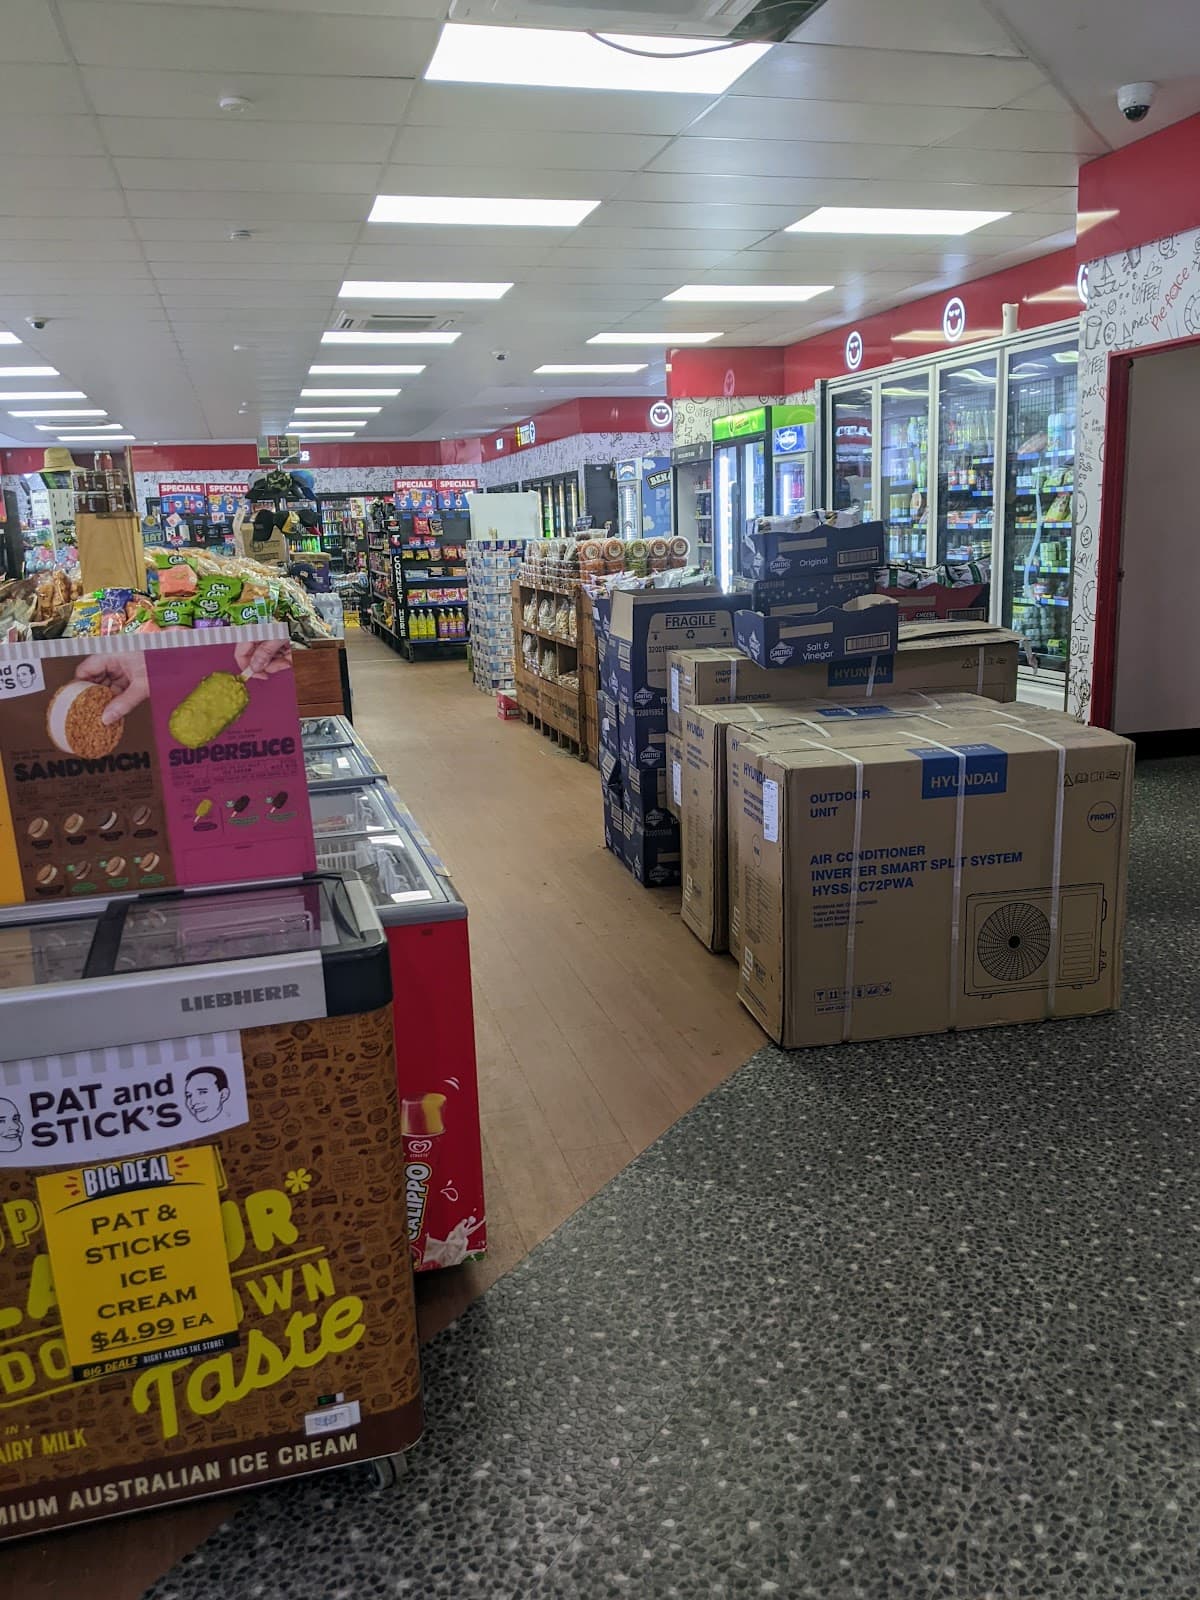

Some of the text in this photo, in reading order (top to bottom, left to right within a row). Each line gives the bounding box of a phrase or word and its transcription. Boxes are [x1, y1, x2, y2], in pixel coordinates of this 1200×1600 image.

[161, 485, 201, 493] SPECIALS
[209, 485, 249, 493] SPECIALS
[799, 557, 828, 568] Original
[665, 615, 715, 627] FRAGILE
[802, 651, 833, 661] Vinegar
[806, 641, 830, 652] Salt &
[13, 751, 151, 783] SANDWICH
[930, 771, 999, 789] HYUNDAI
[810, 789, 871, 804] OUTDOOR
[810, 806, 838, 818] UNIT
[1090, 811, 1116, 822] FRONT
[810, 853, 832, 866] AIR
[811, 850, 1023, 881] INVERER SMART SPLT SYSTEM
[181, 984, 300, 1012] LIEBHERR
[29, 1072, 174, 1119] PAT and
[31, 1101, 182, 1148] STICK'S
[84, 1154, 175, 1198] BIG DEAL
[91, 1204, 178, 1236] PAT &
[85, 1229, 192, 1265] STICKS
[120, 1265, 168, 1289] ICE
[97, 1286, 198, 1320] CREAM
[90, 1312, 215, 1354] $4.99 EA
[163, 1347, 189, 1360] ACROSS
[189, 1344, 202, 1354] THE
[202, 1339, 225, 1351] STORE!
[83, 1355, 140, 1379] BIG DEALS
[132, 1296, 366, 1440] Taste
[42, 1427, 88, 1454] MILK
[69, 1462, 221, 1512] AUSTRALIAN
[230, 1450, 269, 1475] ICE
[278, 1433, 358, 1464] CREAM
